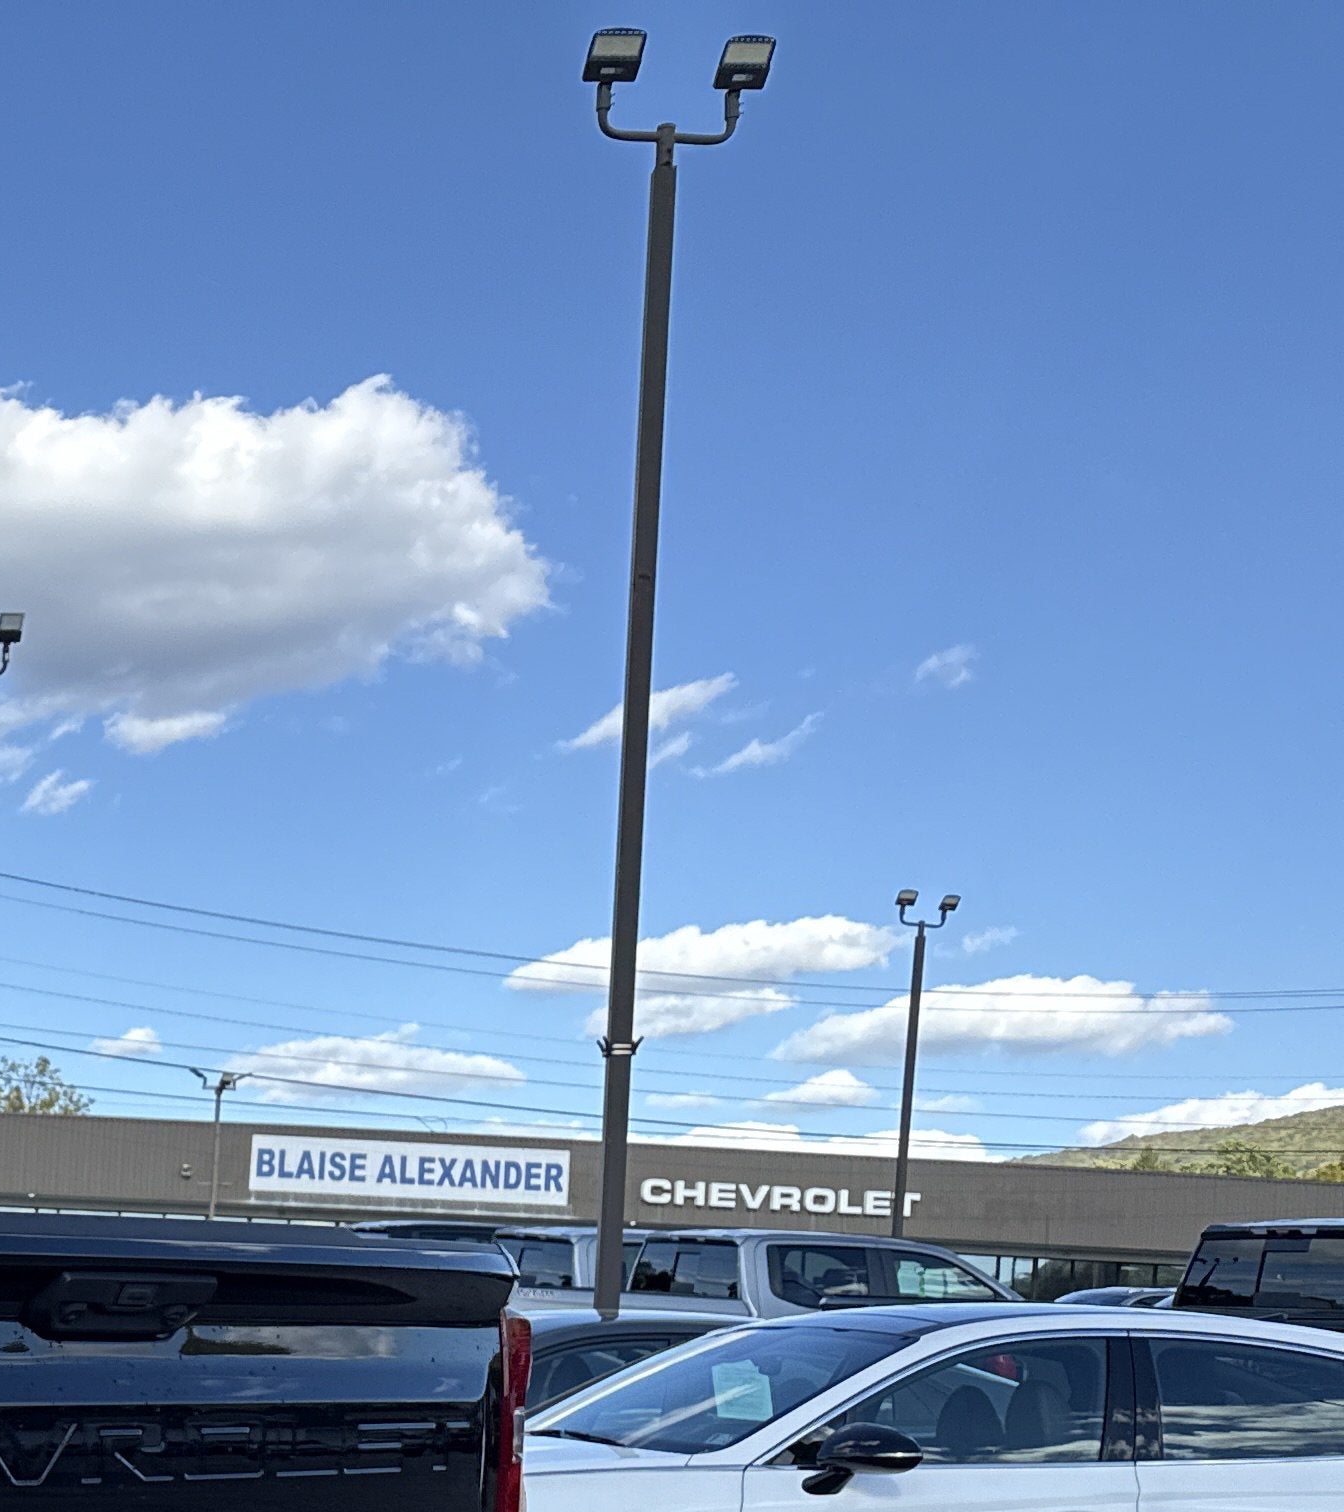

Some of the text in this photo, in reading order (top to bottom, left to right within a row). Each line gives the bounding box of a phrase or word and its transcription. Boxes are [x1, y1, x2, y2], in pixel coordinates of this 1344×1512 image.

[255, 1148, 564, 1193] BLAISE ALEXANDER
[639, 1178, 922, 1218] CHEVROLET
